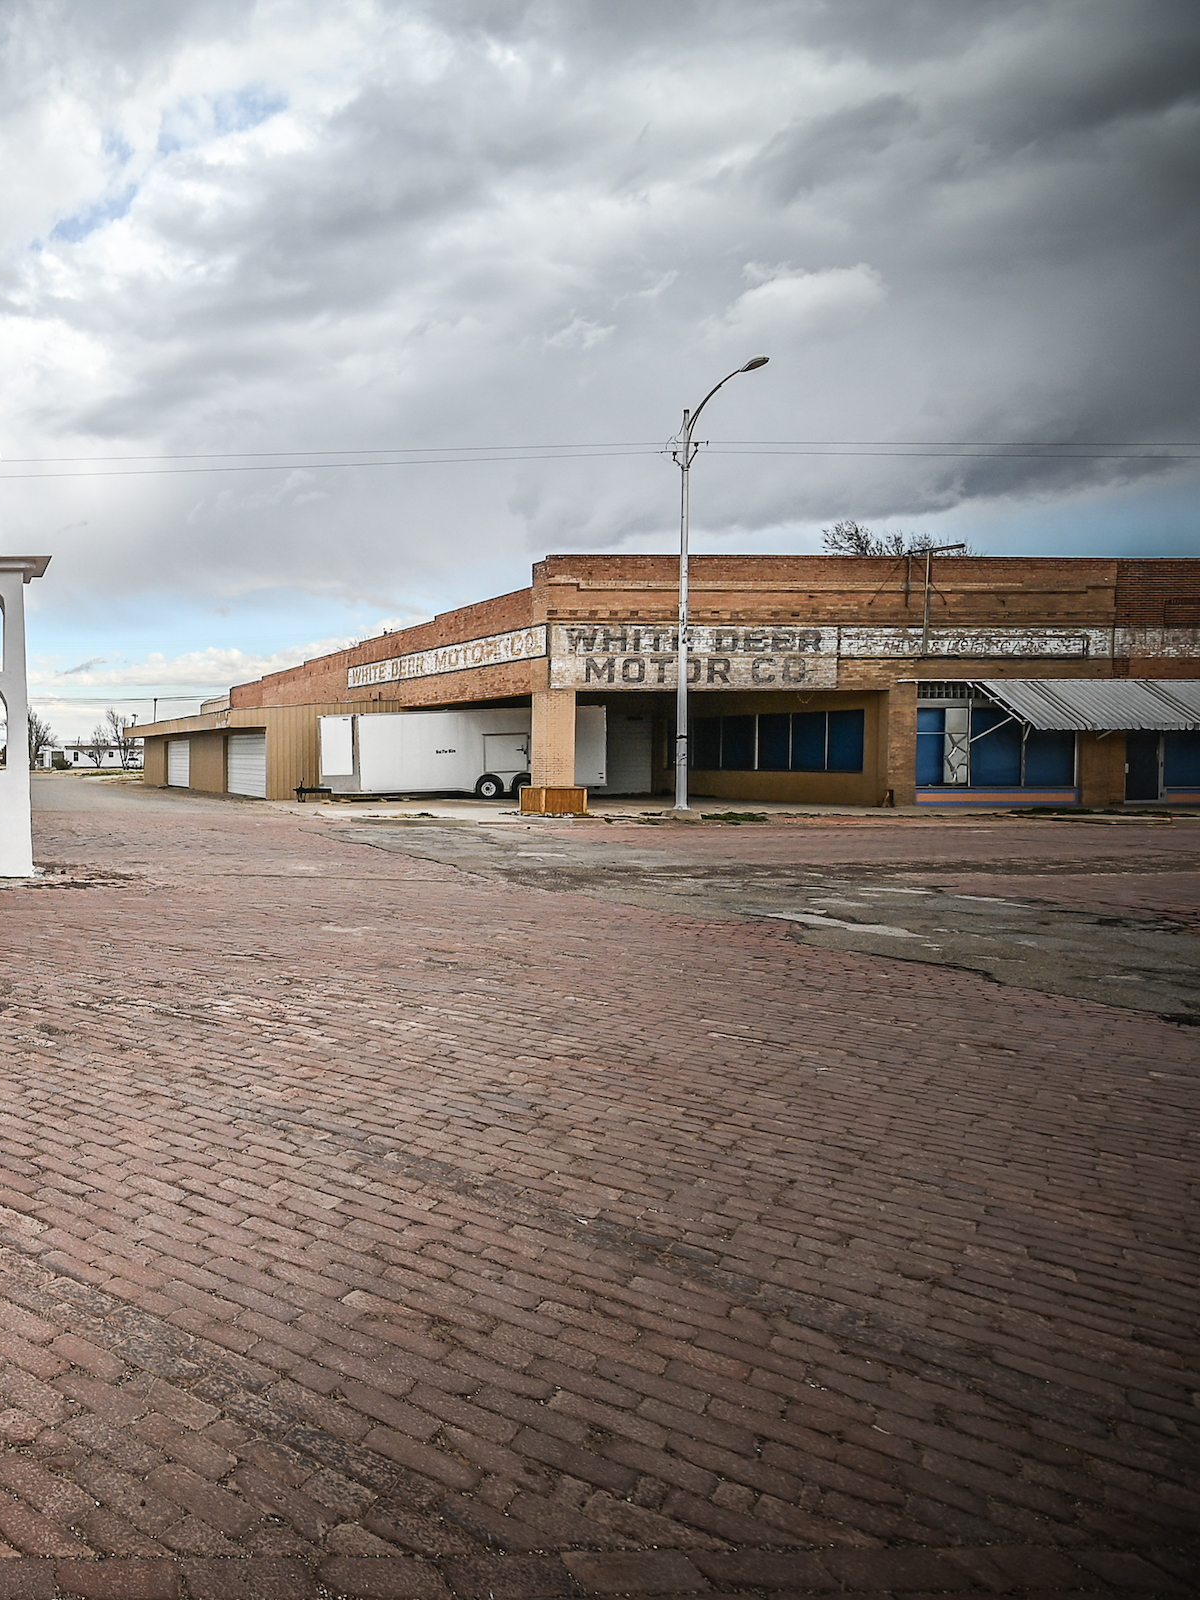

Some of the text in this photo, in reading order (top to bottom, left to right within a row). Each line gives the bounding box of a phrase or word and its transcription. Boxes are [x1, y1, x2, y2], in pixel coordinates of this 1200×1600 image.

[565, 628, 694, 652] WHITE
[715, 629, 822, 652] DEER
[351, 664, 386, 684] WHITE
[391, 655, 424, 677] DEER
[585, 657, 731, 684] MOTOR
